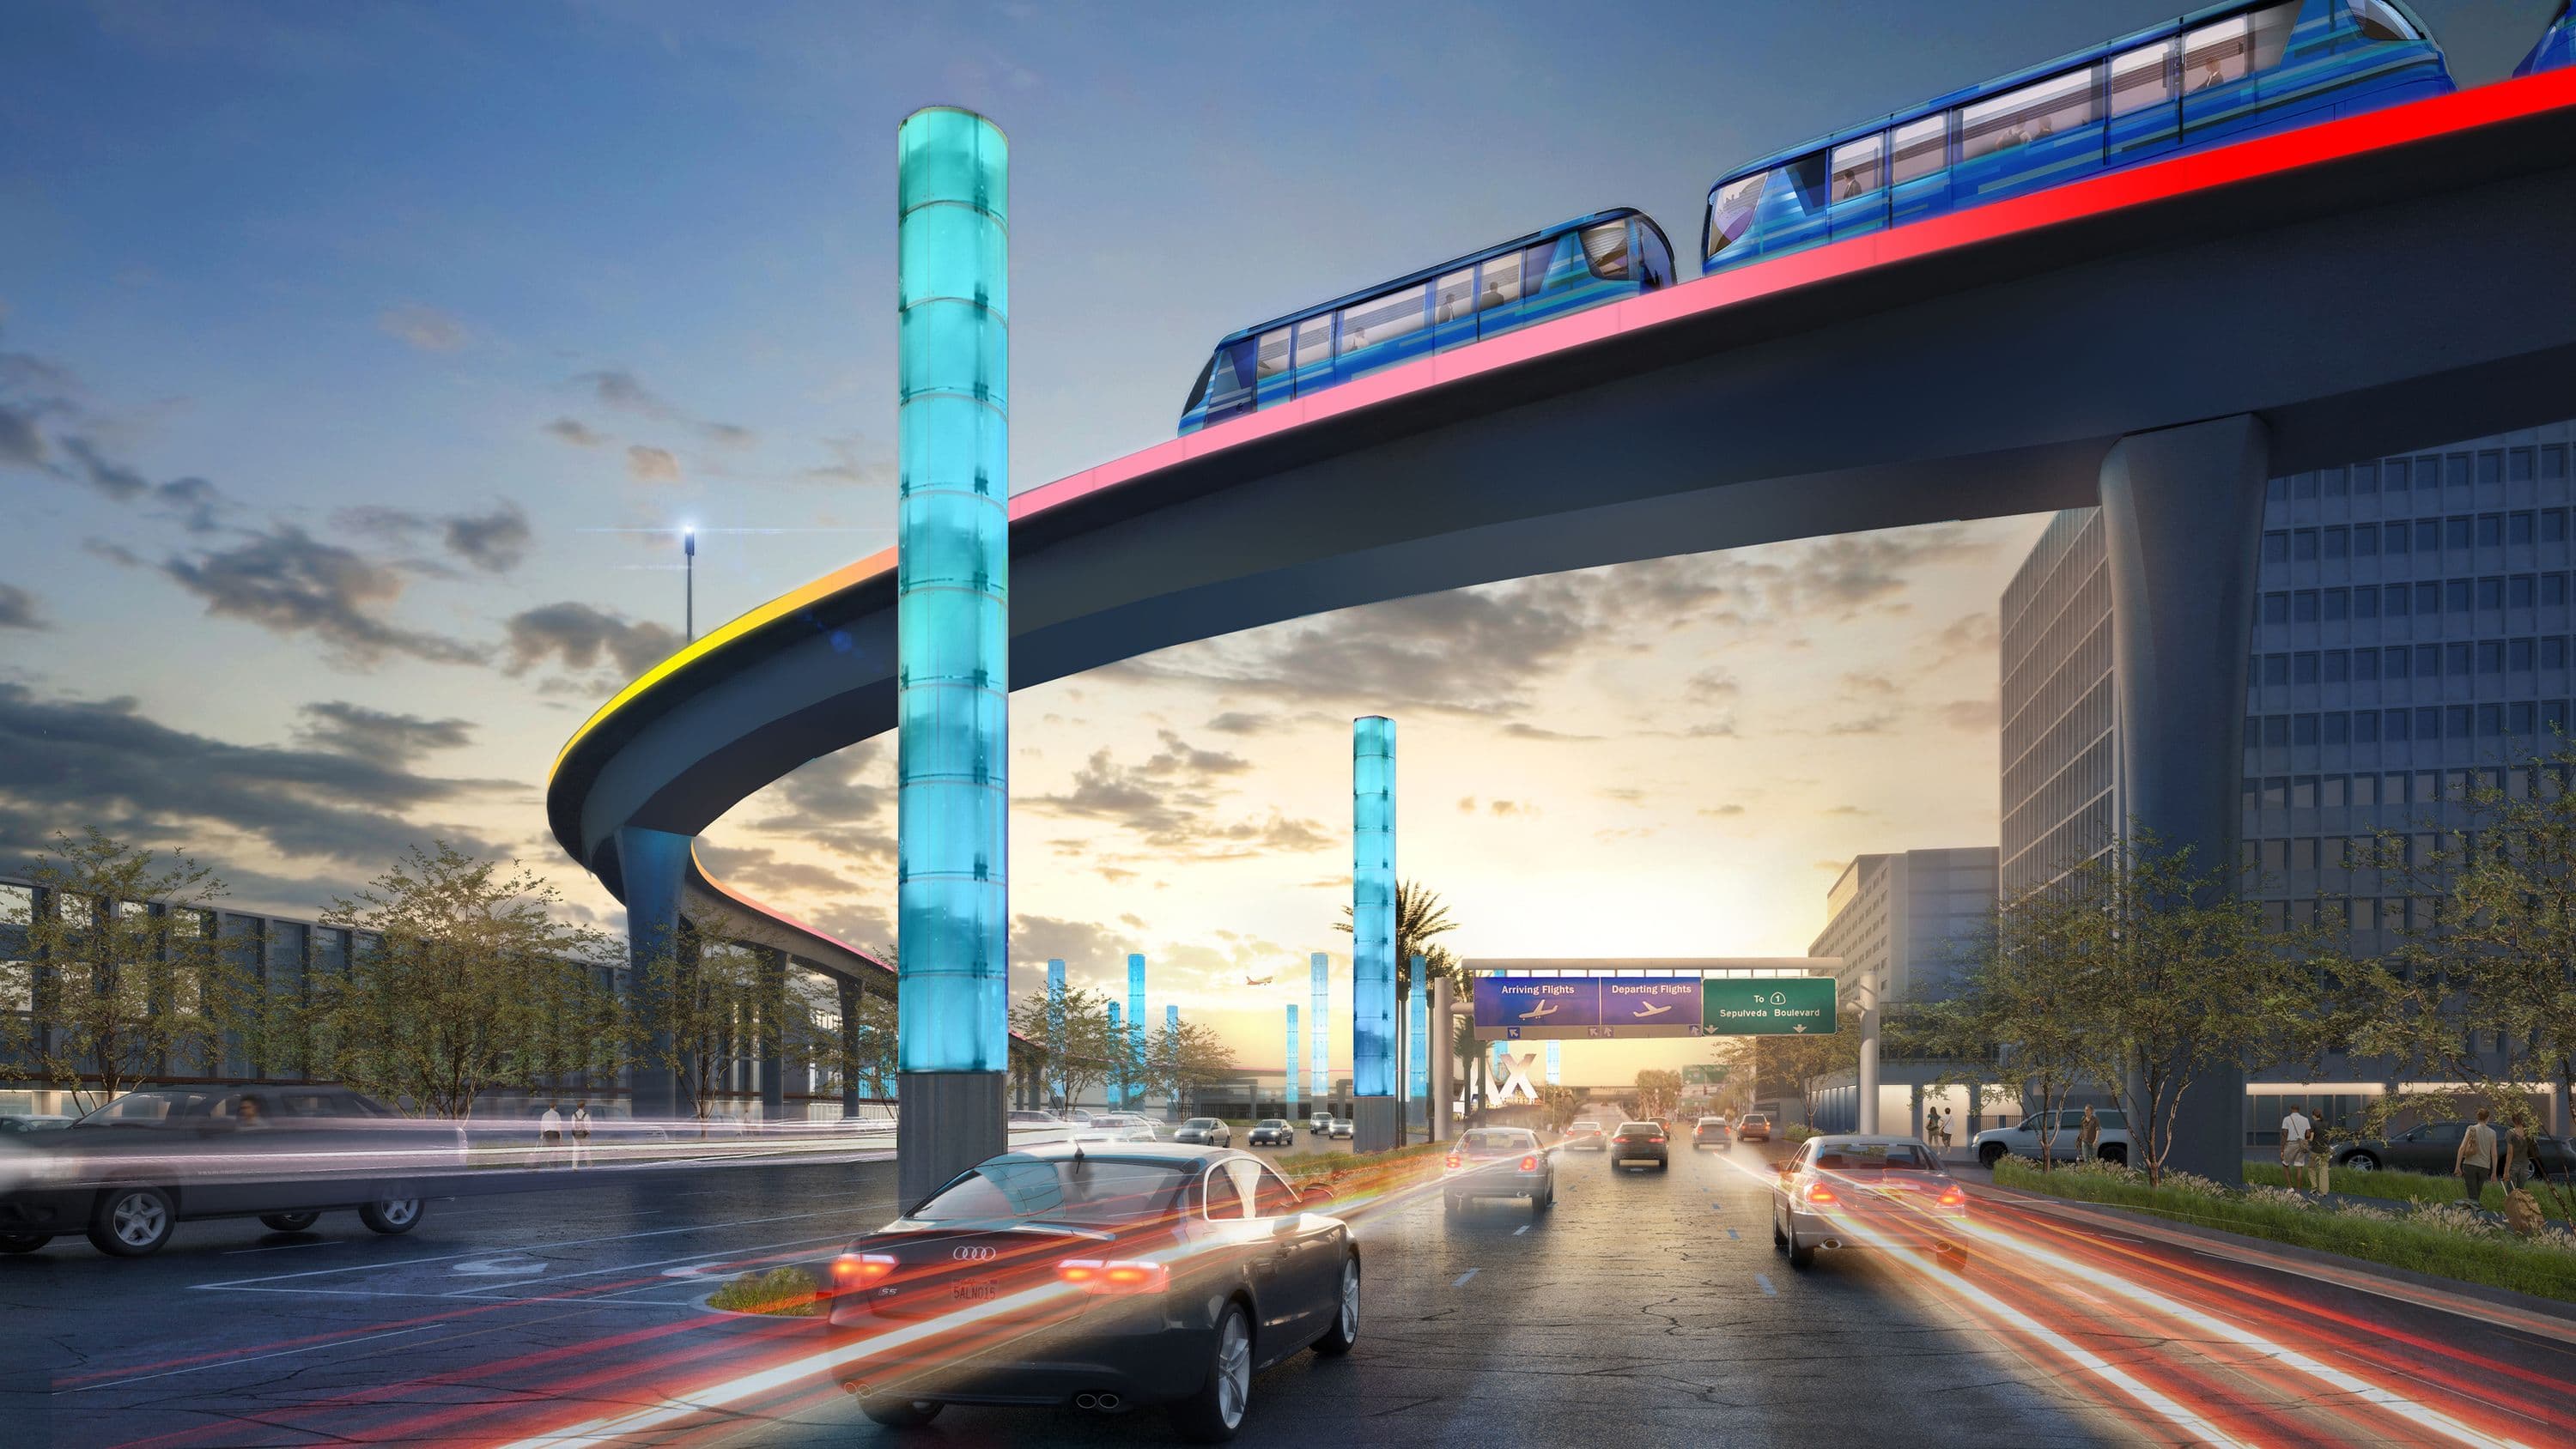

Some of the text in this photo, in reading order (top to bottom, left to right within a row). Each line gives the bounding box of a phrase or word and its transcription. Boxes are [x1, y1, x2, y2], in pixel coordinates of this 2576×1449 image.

[1501, 985, 1575, 996] Arriving Flights
[1612, 985, 1692, 995] Departing Flights
[1720, 1009, 1820, 1019] Sepulveda Boulevard
[1454, 1053, 1541, 1114] AX
